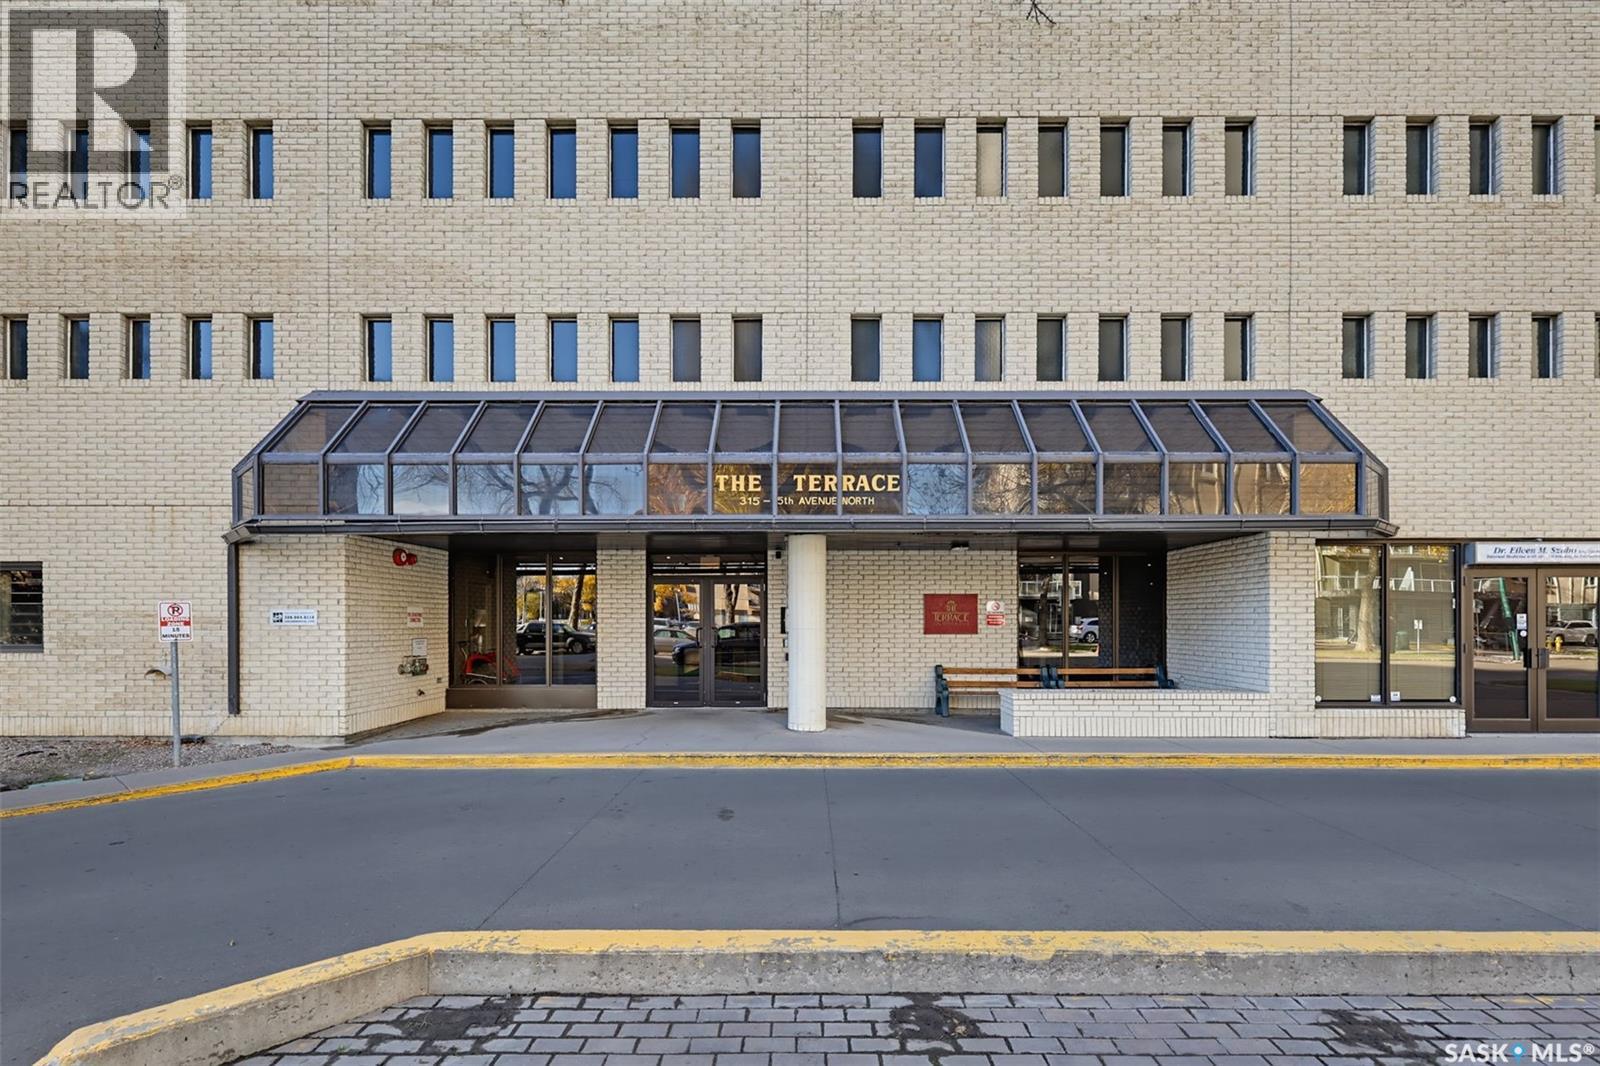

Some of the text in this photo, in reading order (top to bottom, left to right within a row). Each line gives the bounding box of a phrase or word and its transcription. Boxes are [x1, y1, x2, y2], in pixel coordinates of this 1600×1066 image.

[715, 474, 900, 492] THE TERRACE
[739, 496, 760, 506] 315
[777, 496, 794, 506] 5th
[798, 496, 837, 506] AVENUE
[842, 496, 875, 506] NORTH
